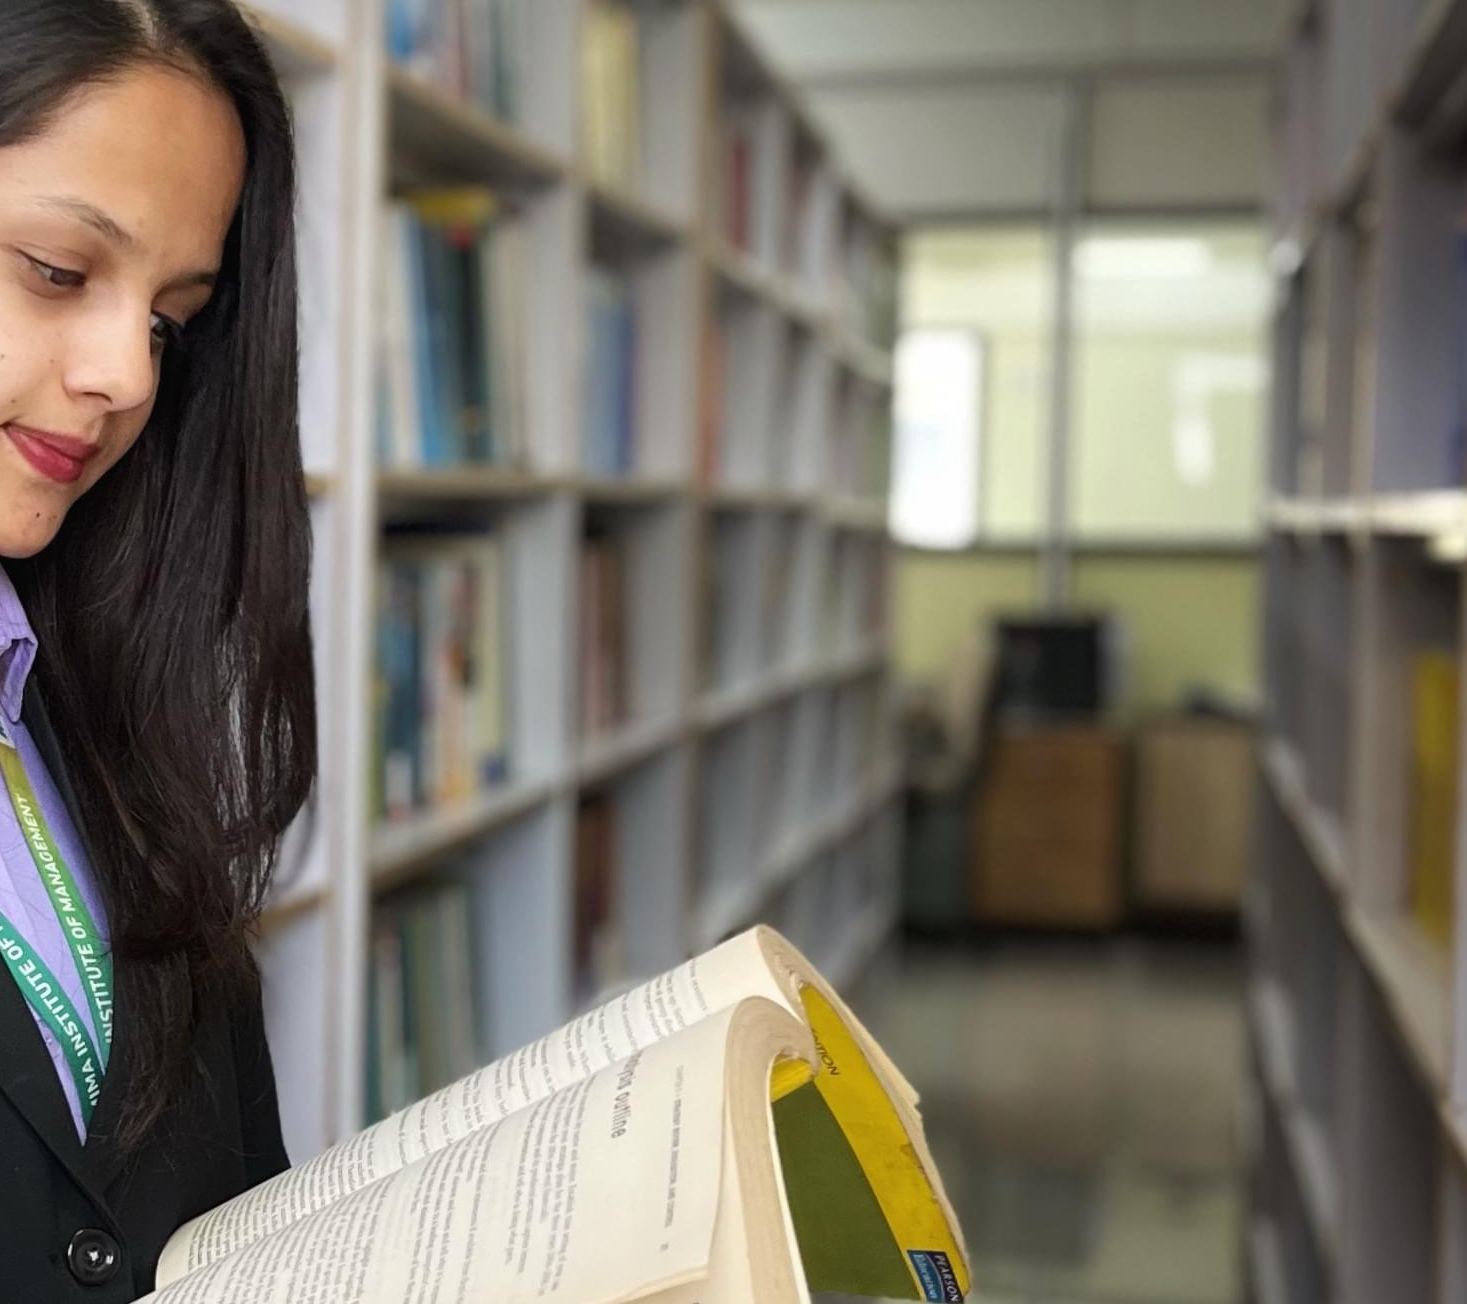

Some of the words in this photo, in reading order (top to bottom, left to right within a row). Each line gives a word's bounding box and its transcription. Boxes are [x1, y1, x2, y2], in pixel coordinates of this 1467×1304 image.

[15, 792, 75, 911] MANAGEMENT
[66, 917, 86, 939] OF
[19, 959, 87, 1056] INSTITUTE
[82, 1058, 100, 1106] IMA
[612, 1092, 631, 1139] outline
[934, 1254, 959, 1303] PEARSON
